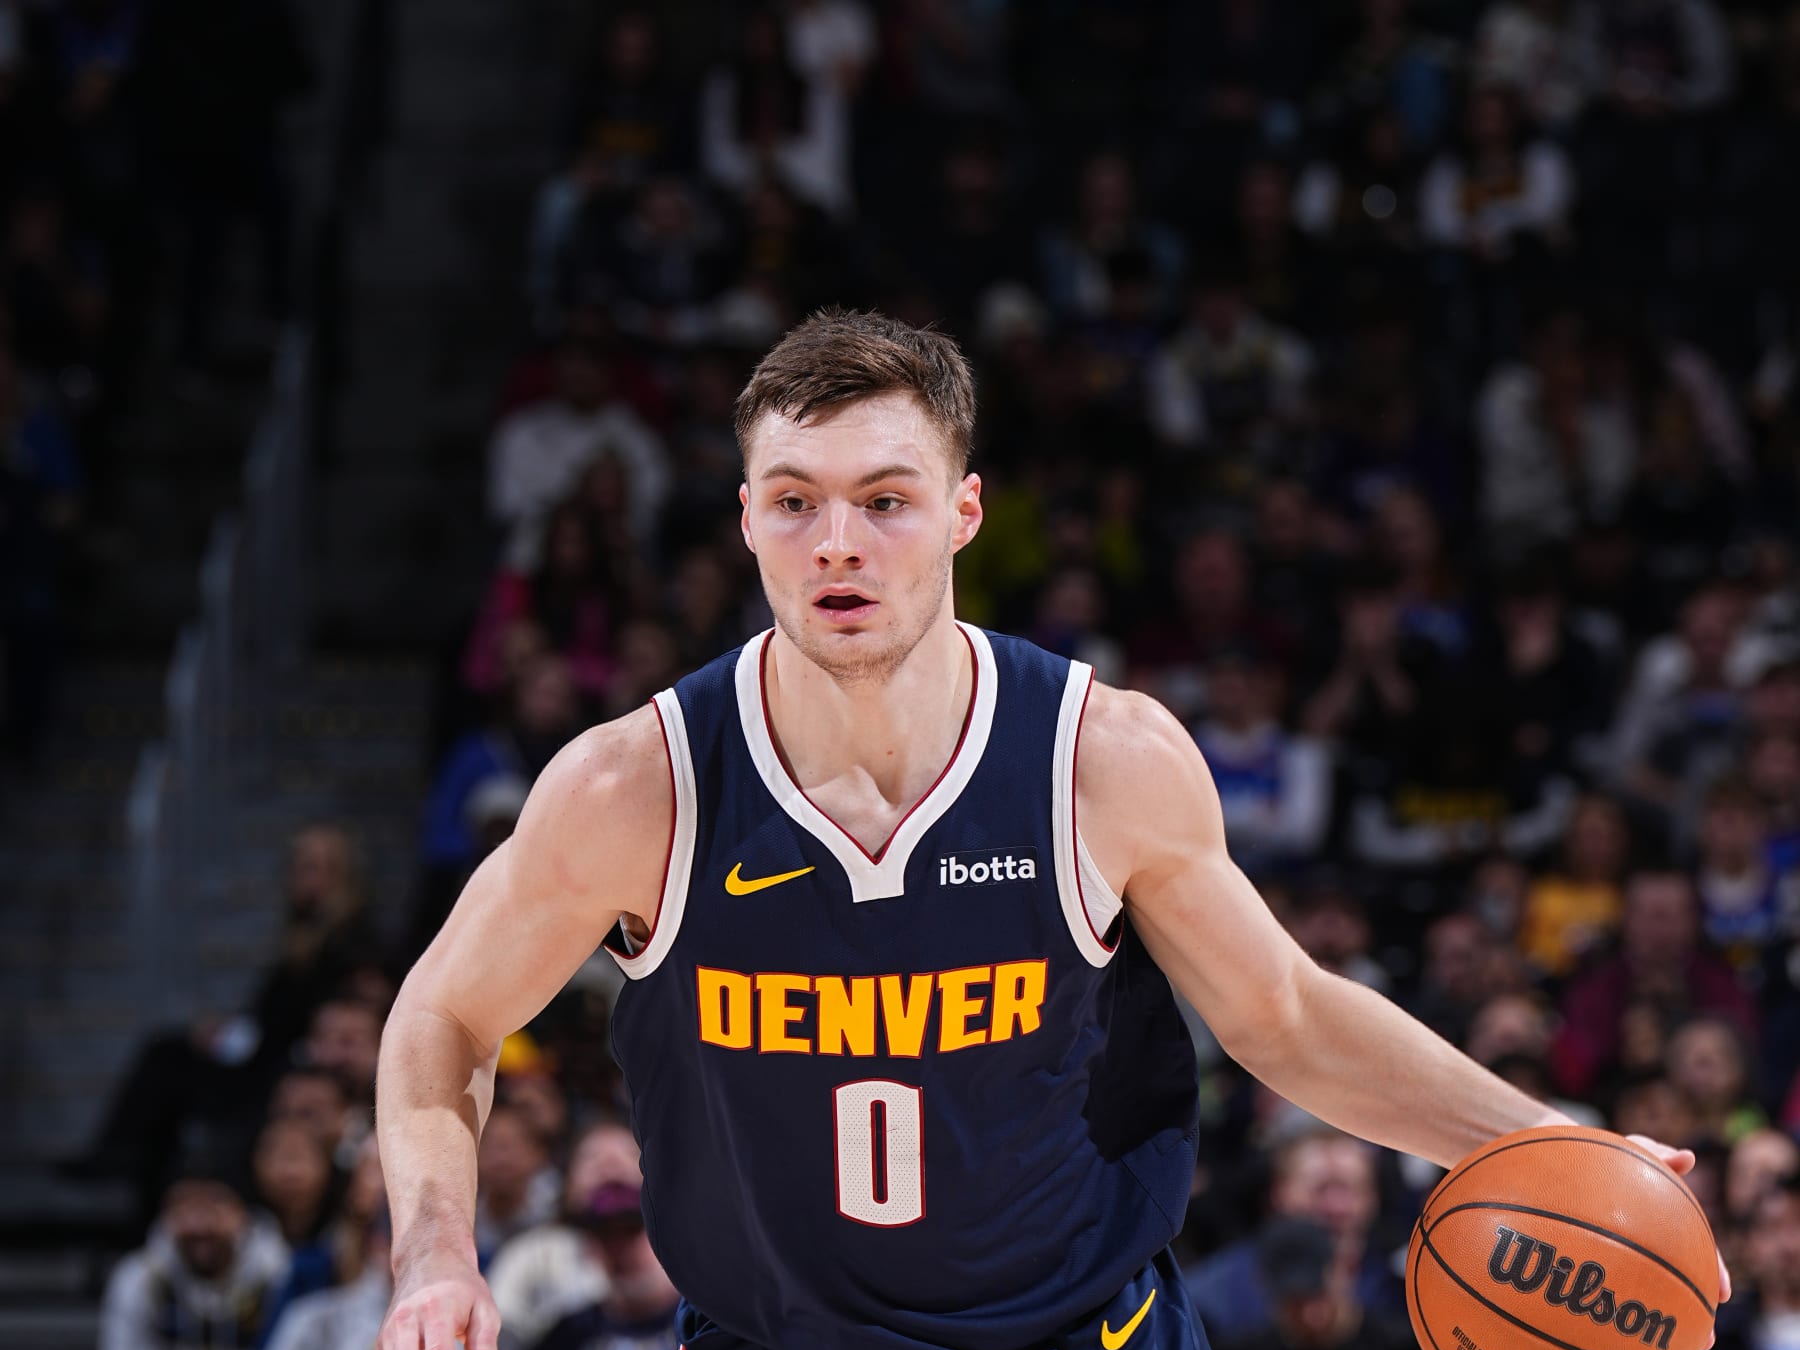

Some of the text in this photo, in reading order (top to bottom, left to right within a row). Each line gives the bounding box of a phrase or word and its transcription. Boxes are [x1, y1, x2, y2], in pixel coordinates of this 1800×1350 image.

[939, 855, 1036, 886] ibotta
[696, 958, 1048, 1059] DENVER
[832, 1078, 926, 1228] 0
